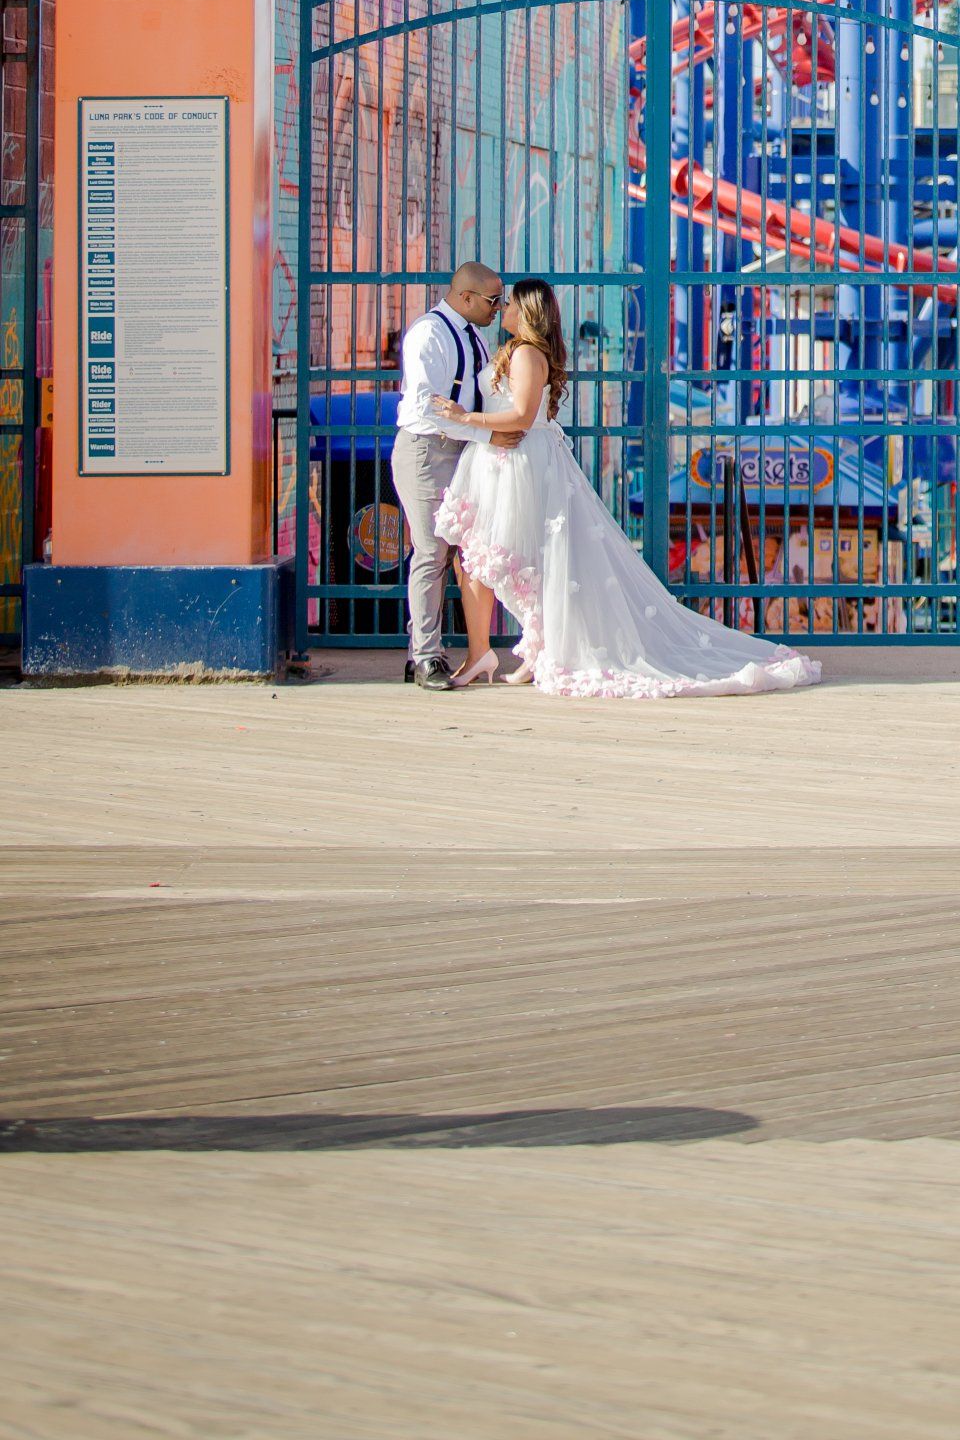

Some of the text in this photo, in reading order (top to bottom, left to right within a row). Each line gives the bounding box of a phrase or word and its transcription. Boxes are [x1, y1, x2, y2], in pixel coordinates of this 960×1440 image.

[89, 113, 110, 121] LUNA
[144, 112, 165, 120] CODE
[168, 112, 178, 120] OF
[182, 112, 218, 120] CONDUCT
[91, 331, 113, 340] Ride
[91, 365, 113, 374] Ride
[716, 453, 809, 483] Tckets
